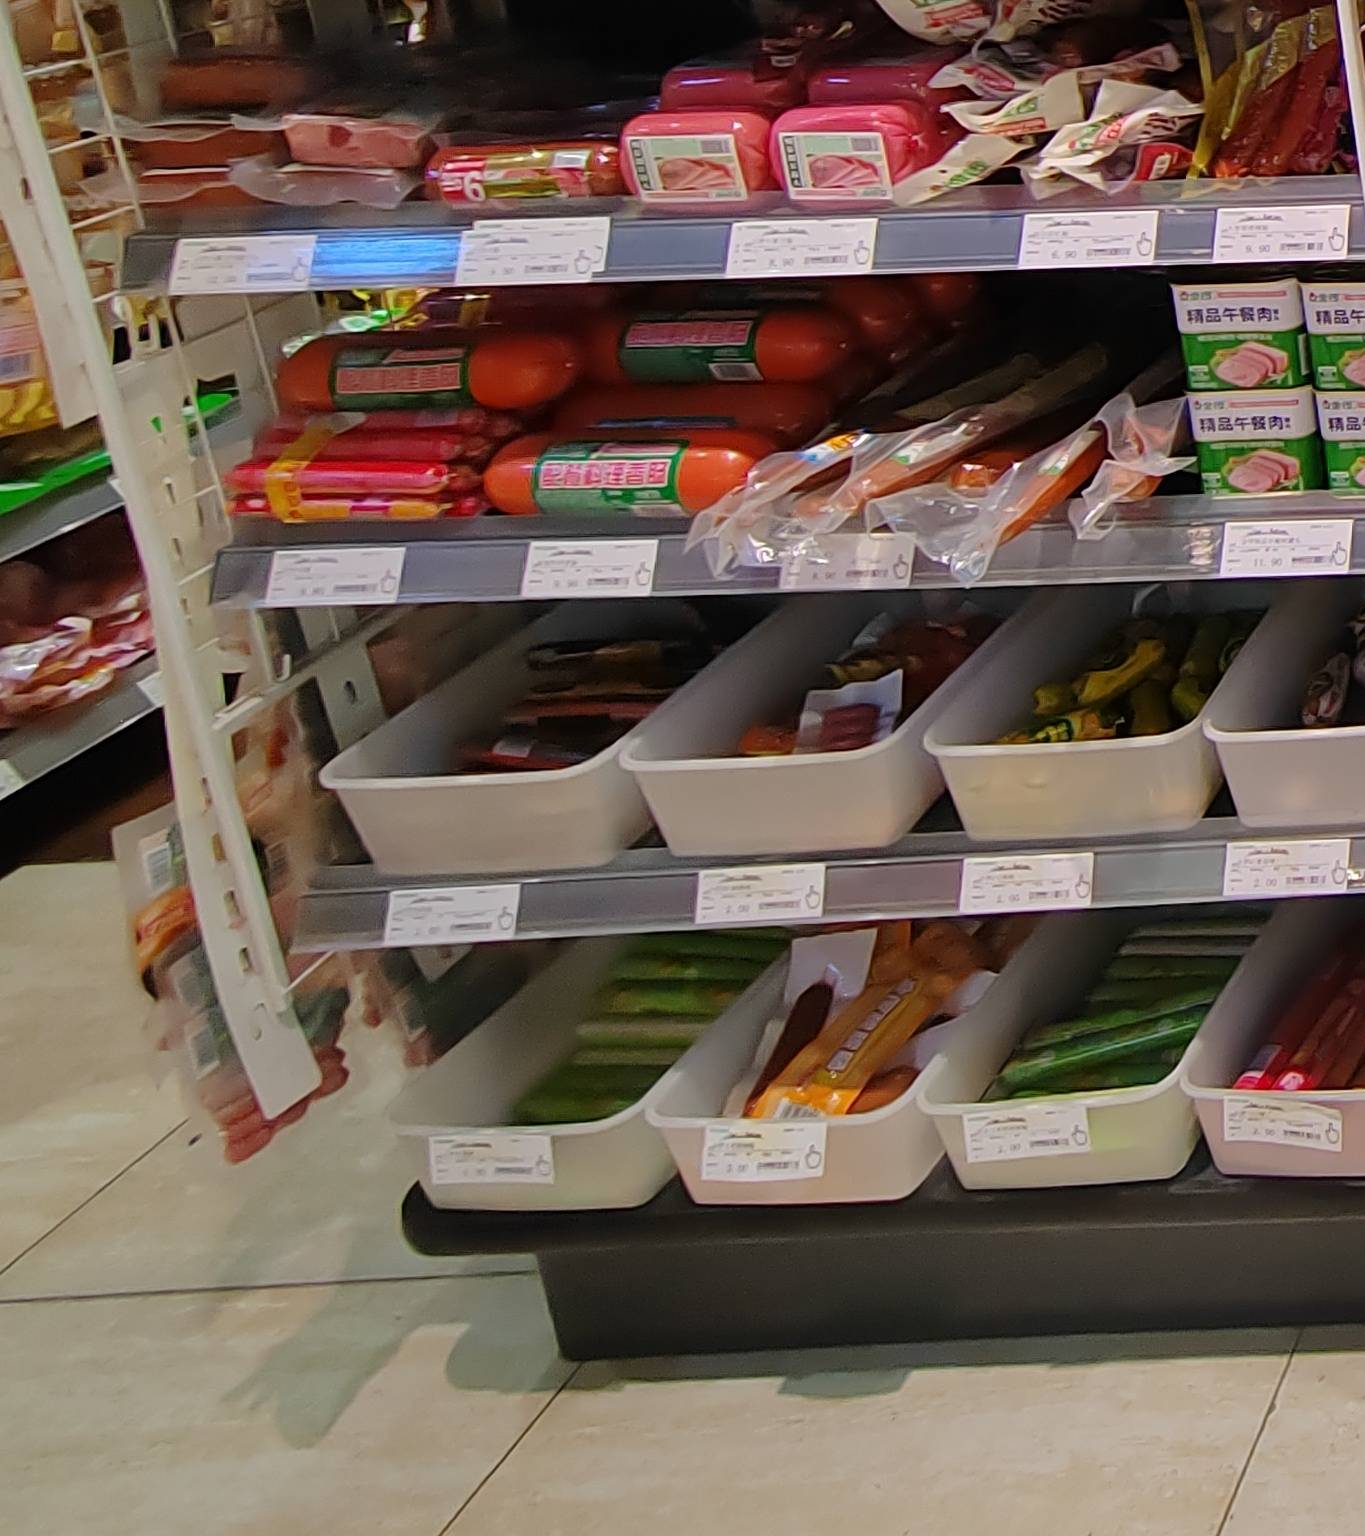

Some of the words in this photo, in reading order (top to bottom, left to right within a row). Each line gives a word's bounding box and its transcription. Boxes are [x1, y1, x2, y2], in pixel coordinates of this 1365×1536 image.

[1186, 307, 1273, 324] 精品午餐肉
[1199, 416, 1284, 433] 精品午餐肉
